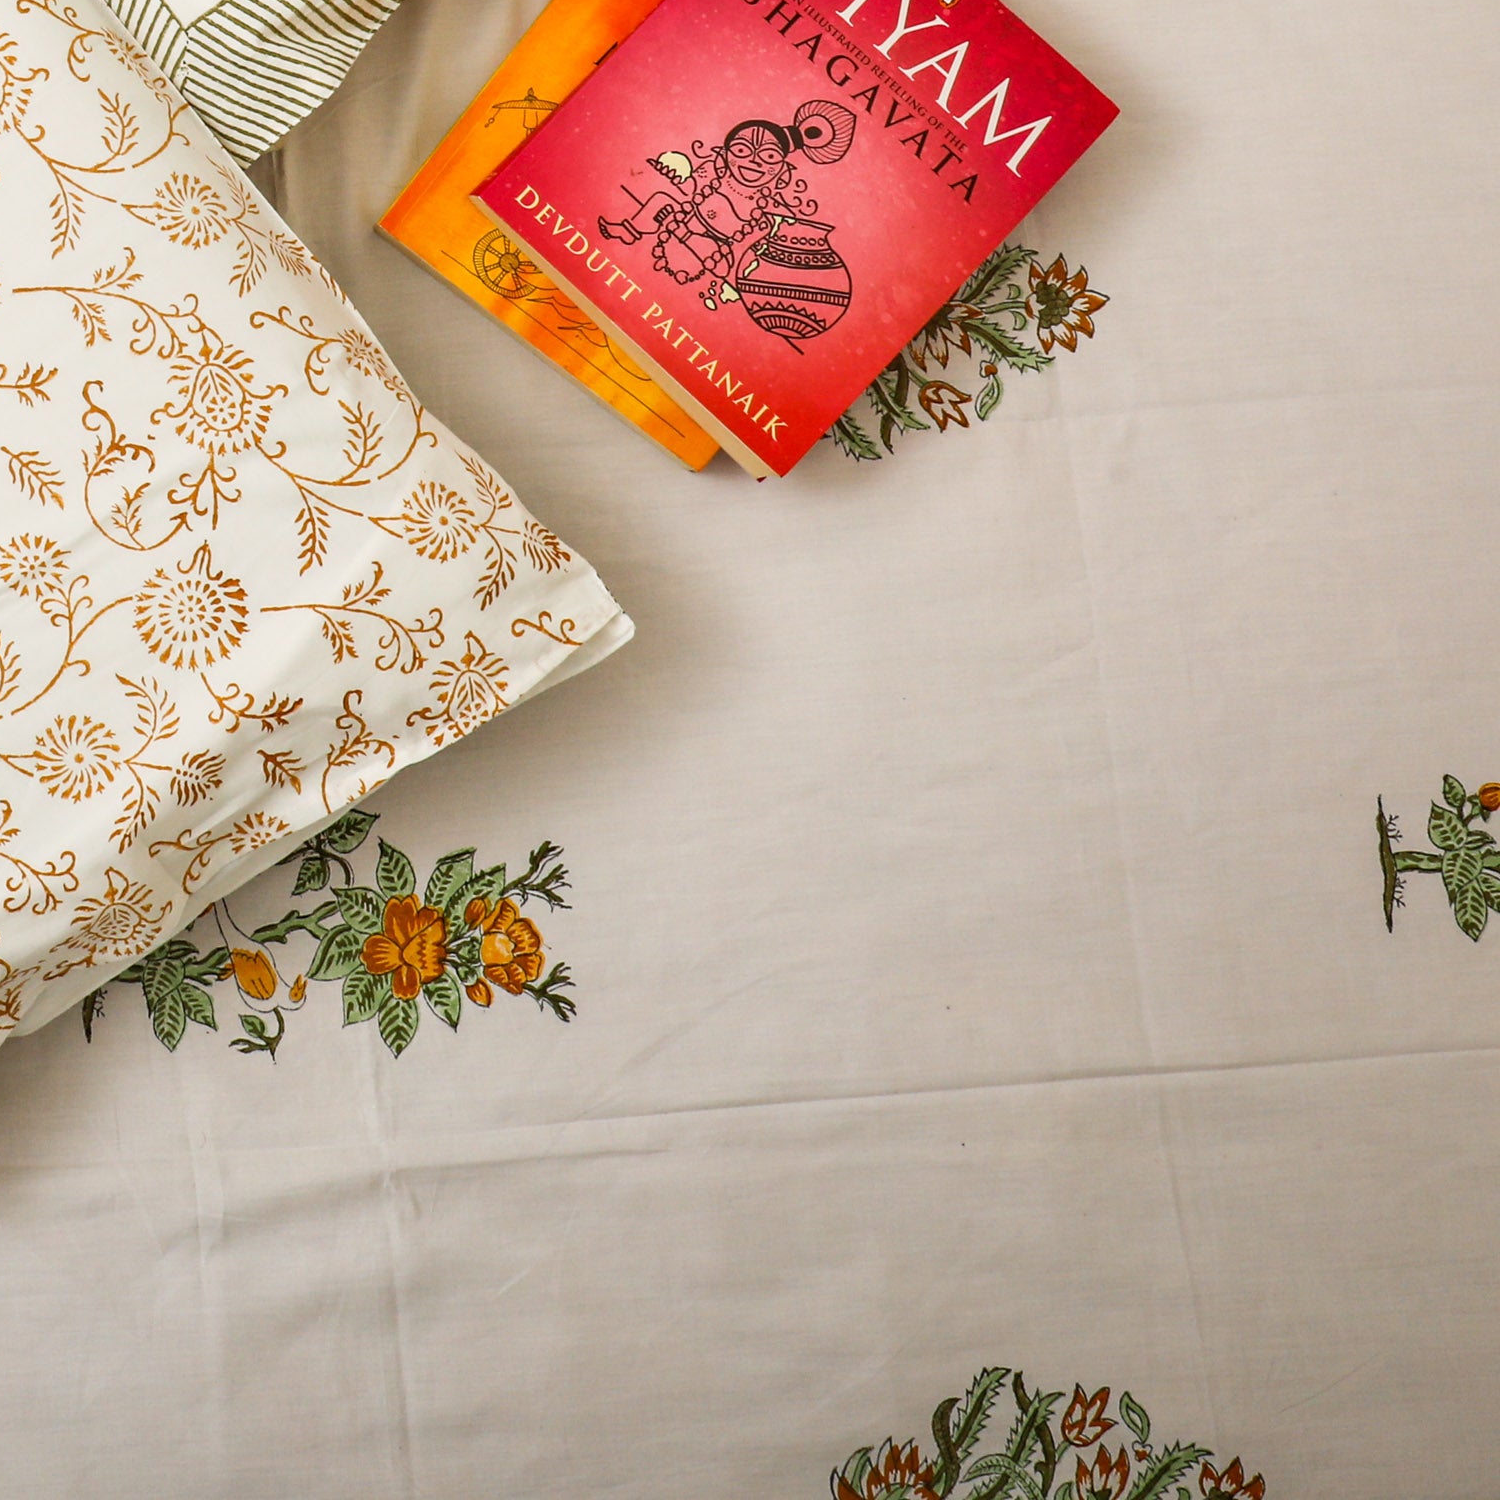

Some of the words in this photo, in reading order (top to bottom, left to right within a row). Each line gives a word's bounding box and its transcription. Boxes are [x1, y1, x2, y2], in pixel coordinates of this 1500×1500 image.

[803, 3, 873, 67] ILLUSTRATED
[870, 65, 927, 117] RETELLING
[926, 114, 947, 134] OF
[942, 128, 968, 154] THE
[515, 185, 642, 302] DEVDUTT
[641, 302, 787, 441] PATTANAIK
